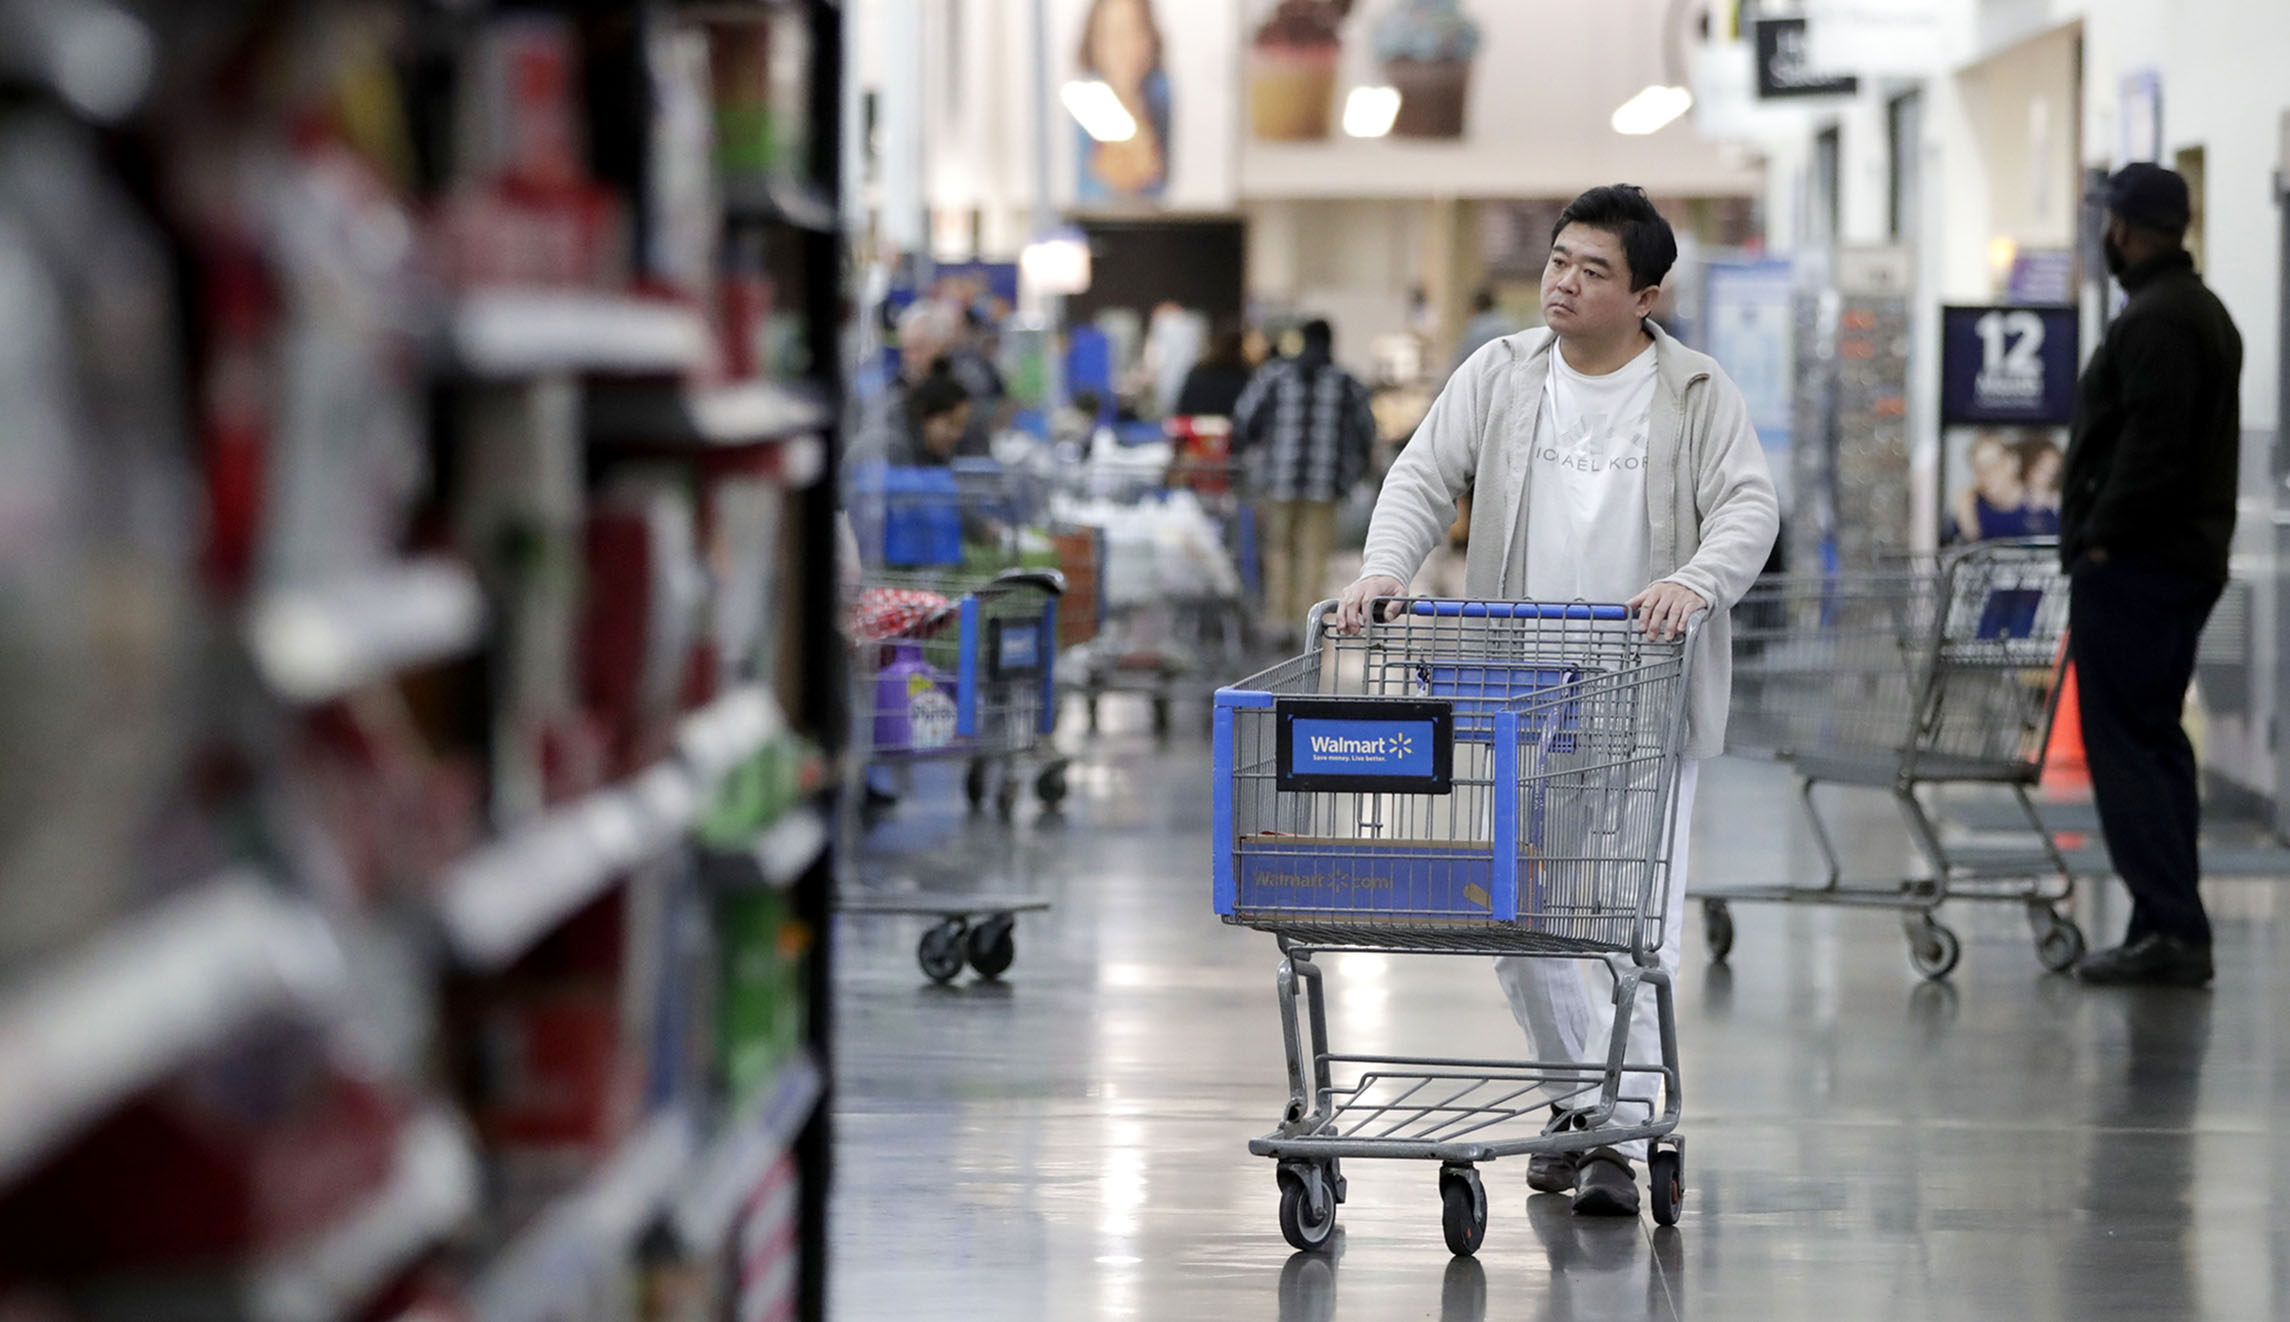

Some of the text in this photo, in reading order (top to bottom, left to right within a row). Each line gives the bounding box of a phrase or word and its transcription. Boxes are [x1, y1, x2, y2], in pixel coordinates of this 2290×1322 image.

[1975, 310, 2045, 378] 12
[1536, 448, 1600, 472] ICAEL
[1310, 736, 1385, 753] Walmart
[1253, 871, 1324, 888] Walmart
